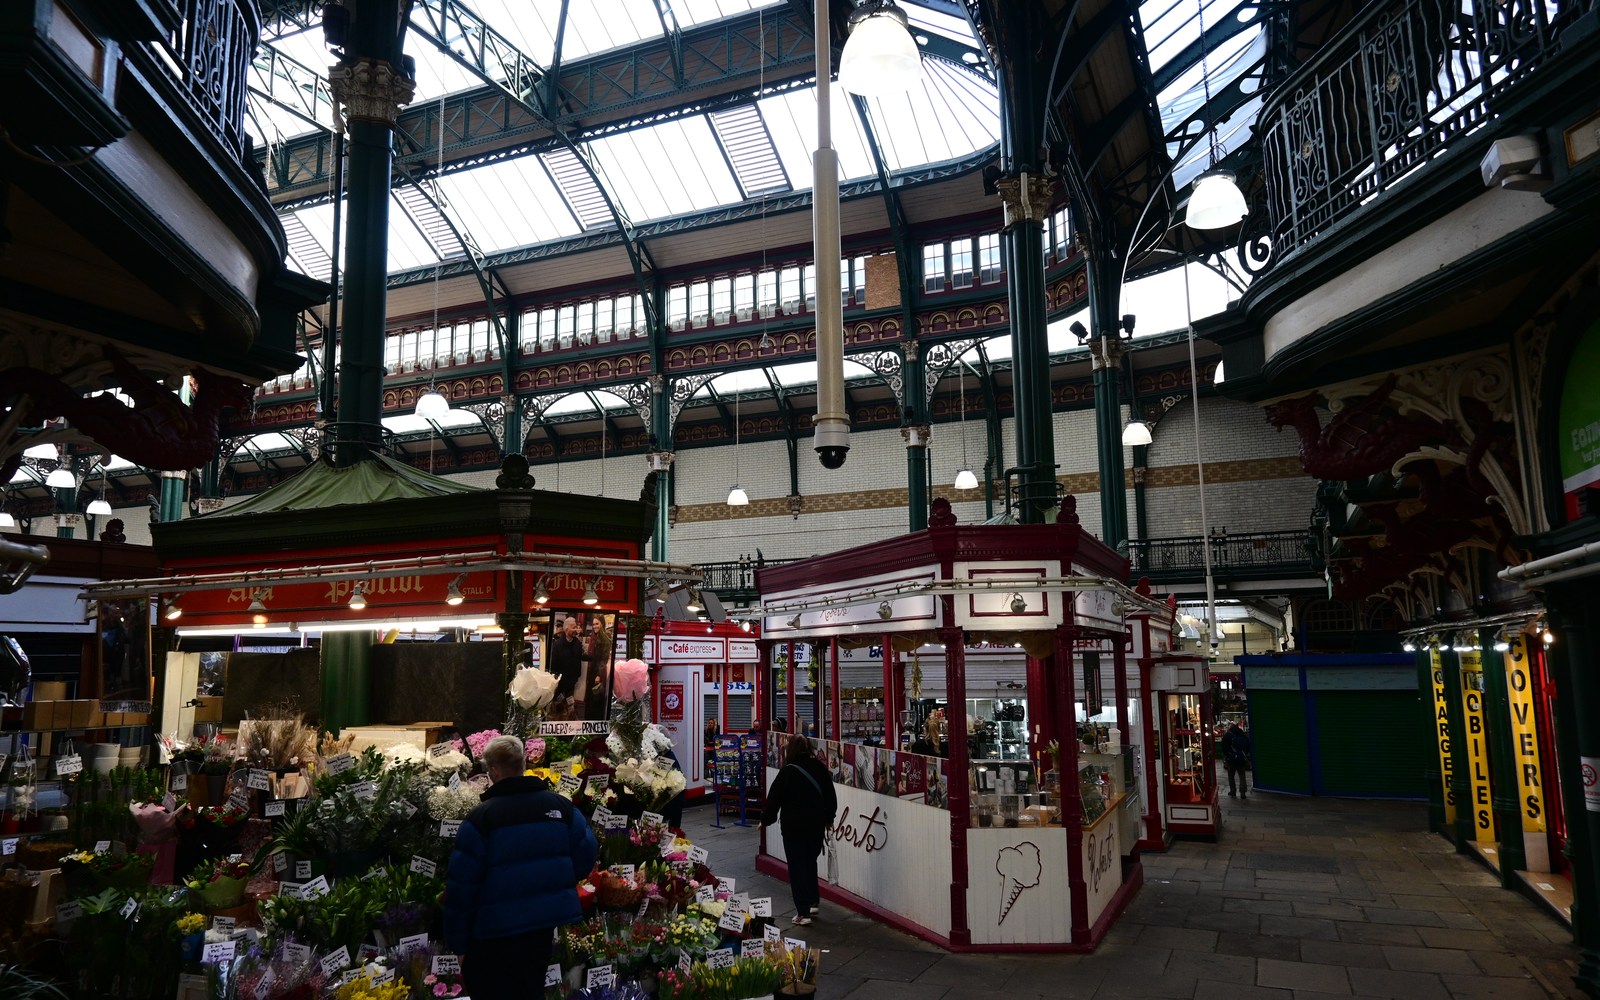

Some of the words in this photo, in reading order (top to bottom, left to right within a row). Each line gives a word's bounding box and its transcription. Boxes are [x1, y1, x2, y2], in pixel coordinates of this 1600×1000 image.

[462, 587, 484, 595] STALL
[673, 643, 689, 654] Café
[690, 645, 712, 656] express
[582, 722, 608, 733] PRINCESS
[1509, 637, 1541, 819] COVERS
[1434, 671, 1456, 807] CHARGERS
